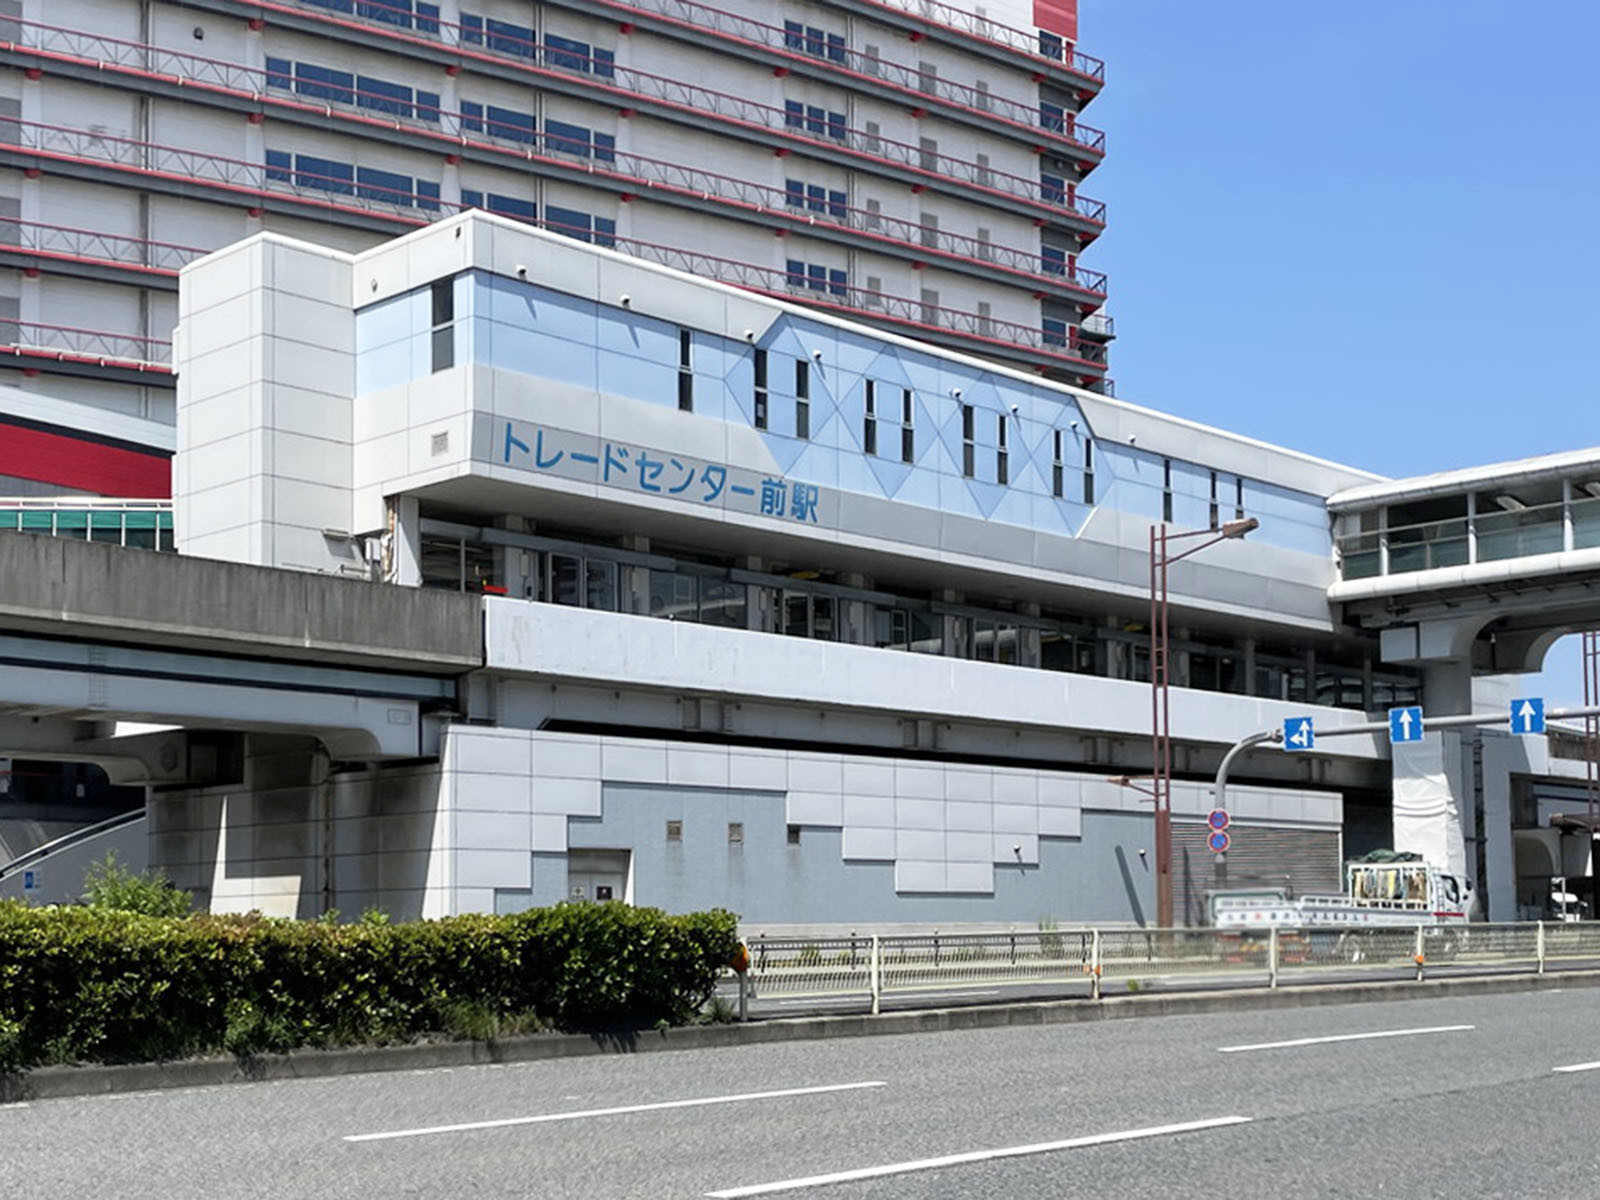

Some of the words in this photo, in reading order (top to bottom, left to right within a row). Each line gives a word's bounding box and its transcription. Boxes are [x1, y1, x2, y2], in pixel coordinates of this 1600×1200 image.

[504, 422, 819, 523] トレードセンター前駅
